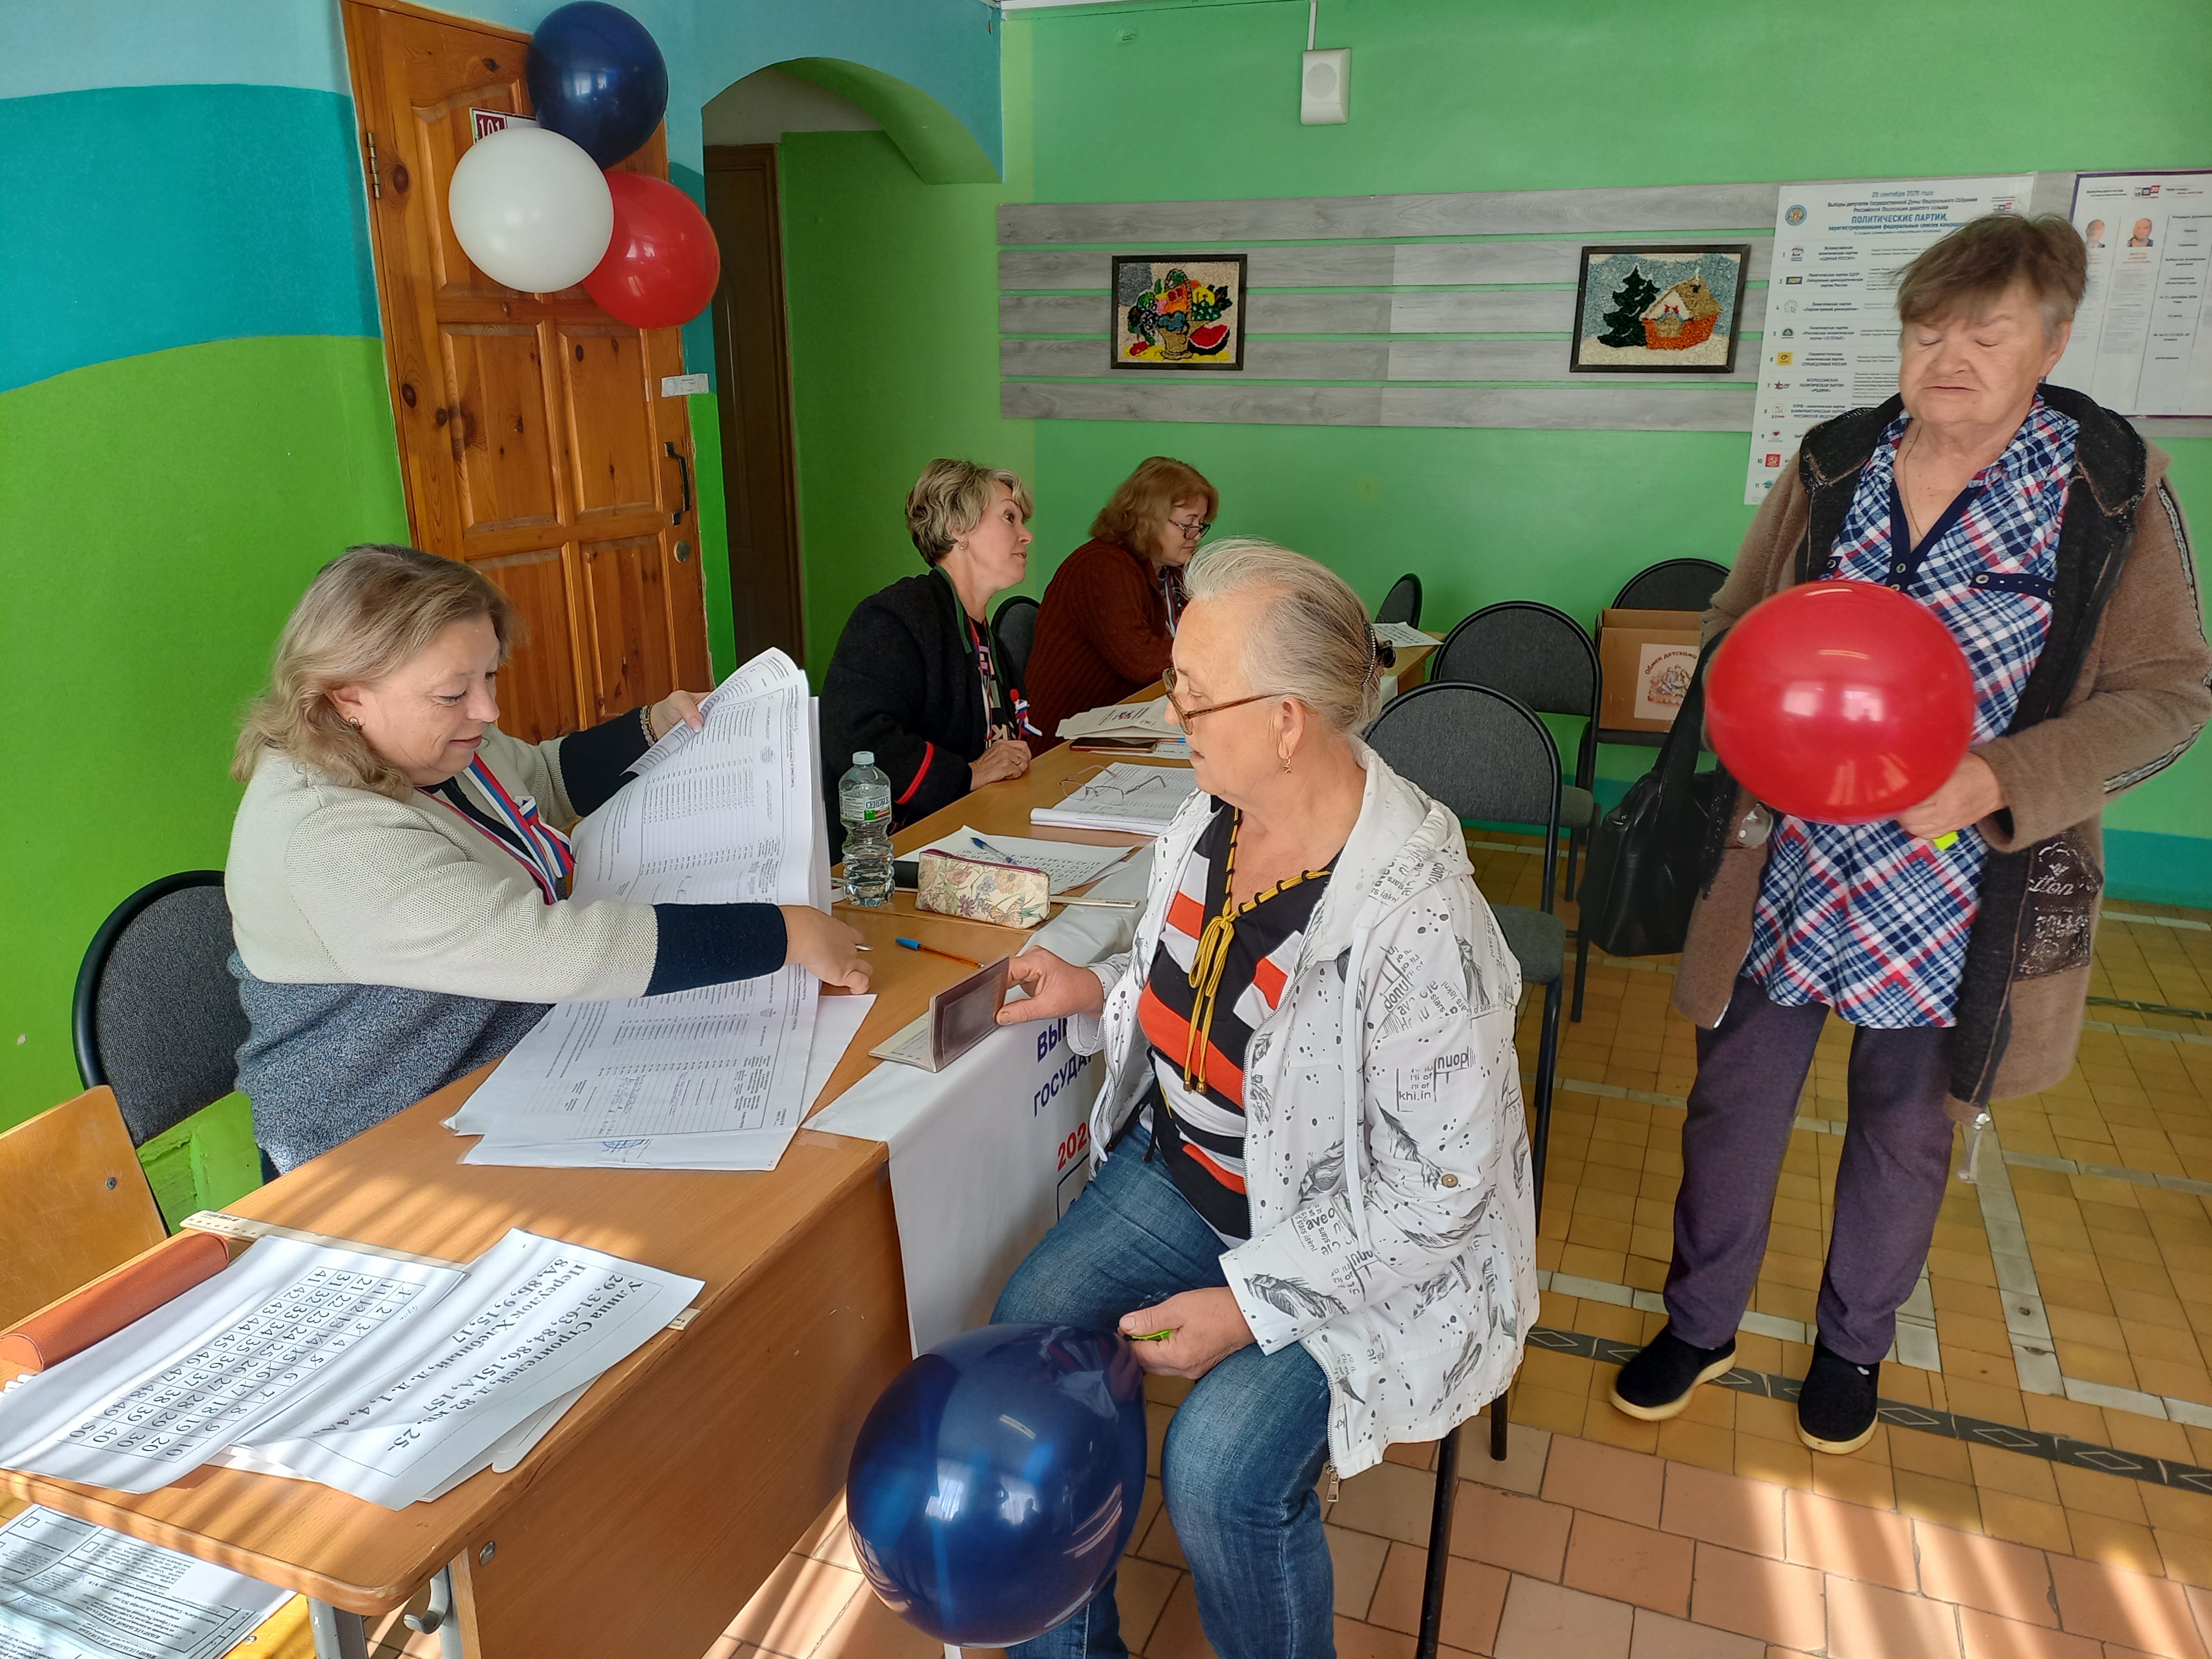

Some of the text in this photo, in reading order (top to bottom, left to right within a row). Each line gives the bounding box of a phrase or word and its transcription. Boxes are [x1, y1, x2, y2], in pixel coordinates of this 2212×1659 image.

[1851, 213, 1948, 223] ПОЛИТИЧЕСКИЕ ПАРТИИ,
[1057, 1122, 1091, 1172] 202
[510, 1264, 588, 1319] Переулок
[595, 1274, 623, 1292] 29,
[451, 1259, 568, 1344] 8А, 8Б, 9, 15, 17
[589, 1280, 644, 1319] Улица
[551, 1293, 602, 1326] 31-63,
[427, 1318, 517, 1369] Хлебный,
[526, 1328, 557, 1343] 84,
[70, 1270, 327, 1438] 41 42 43 44 45 46 47 48 49 50
[93, 1274, 351, 1442] 31 32 33 34 35 36 37 38 39 40
[489, 1321, 593, 1384] Строителей,
[500, 1346, 532, 1360] 86,
[117, 1277, 372, 1447] 21 22 23 24 25 26 27 28 29 30
[201, 1401, 228, 1414] 18
[369, 1395, 394, 1404] 1,
[422, 1392, 456, 1412] 157
[450, 1399, 476, 1410] 82
[348, 1406, 371, 1416] 4,
[417, 1410, 450, 1425] кв.
[176, 1419, 200, 1432] 19
[205, 1422, 221, 1433] 9
[142, 1437, 170, 1452] 20
[387, 1427, 421, 1452] 25-
[166, 1443, 193, 1456] 10
